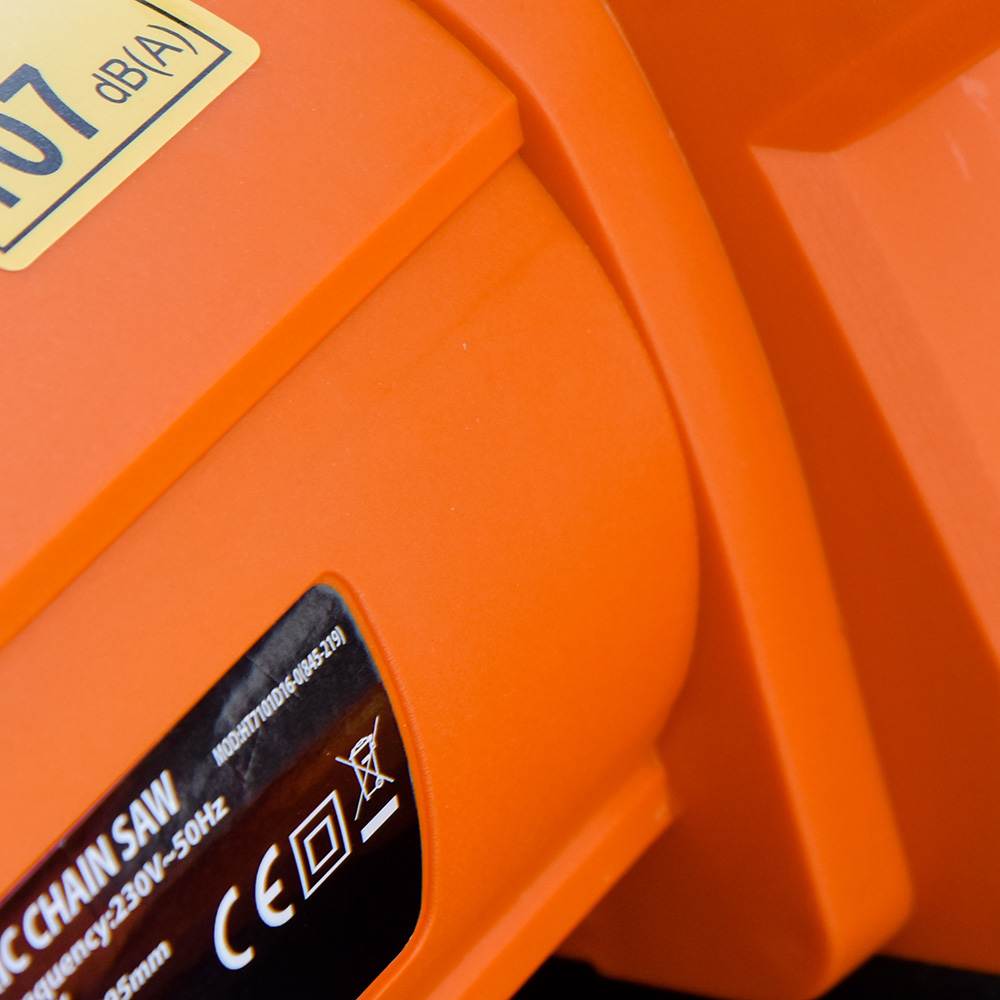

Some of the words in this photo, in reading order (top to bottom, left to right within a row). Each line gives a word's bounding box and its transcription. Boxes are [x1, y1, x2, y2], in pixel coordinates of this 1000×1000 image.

[91, 24, 199, 105] dB(A)
[22, 834, 121, 950] CHAIN
[111, 769, 182, 862] SAW
